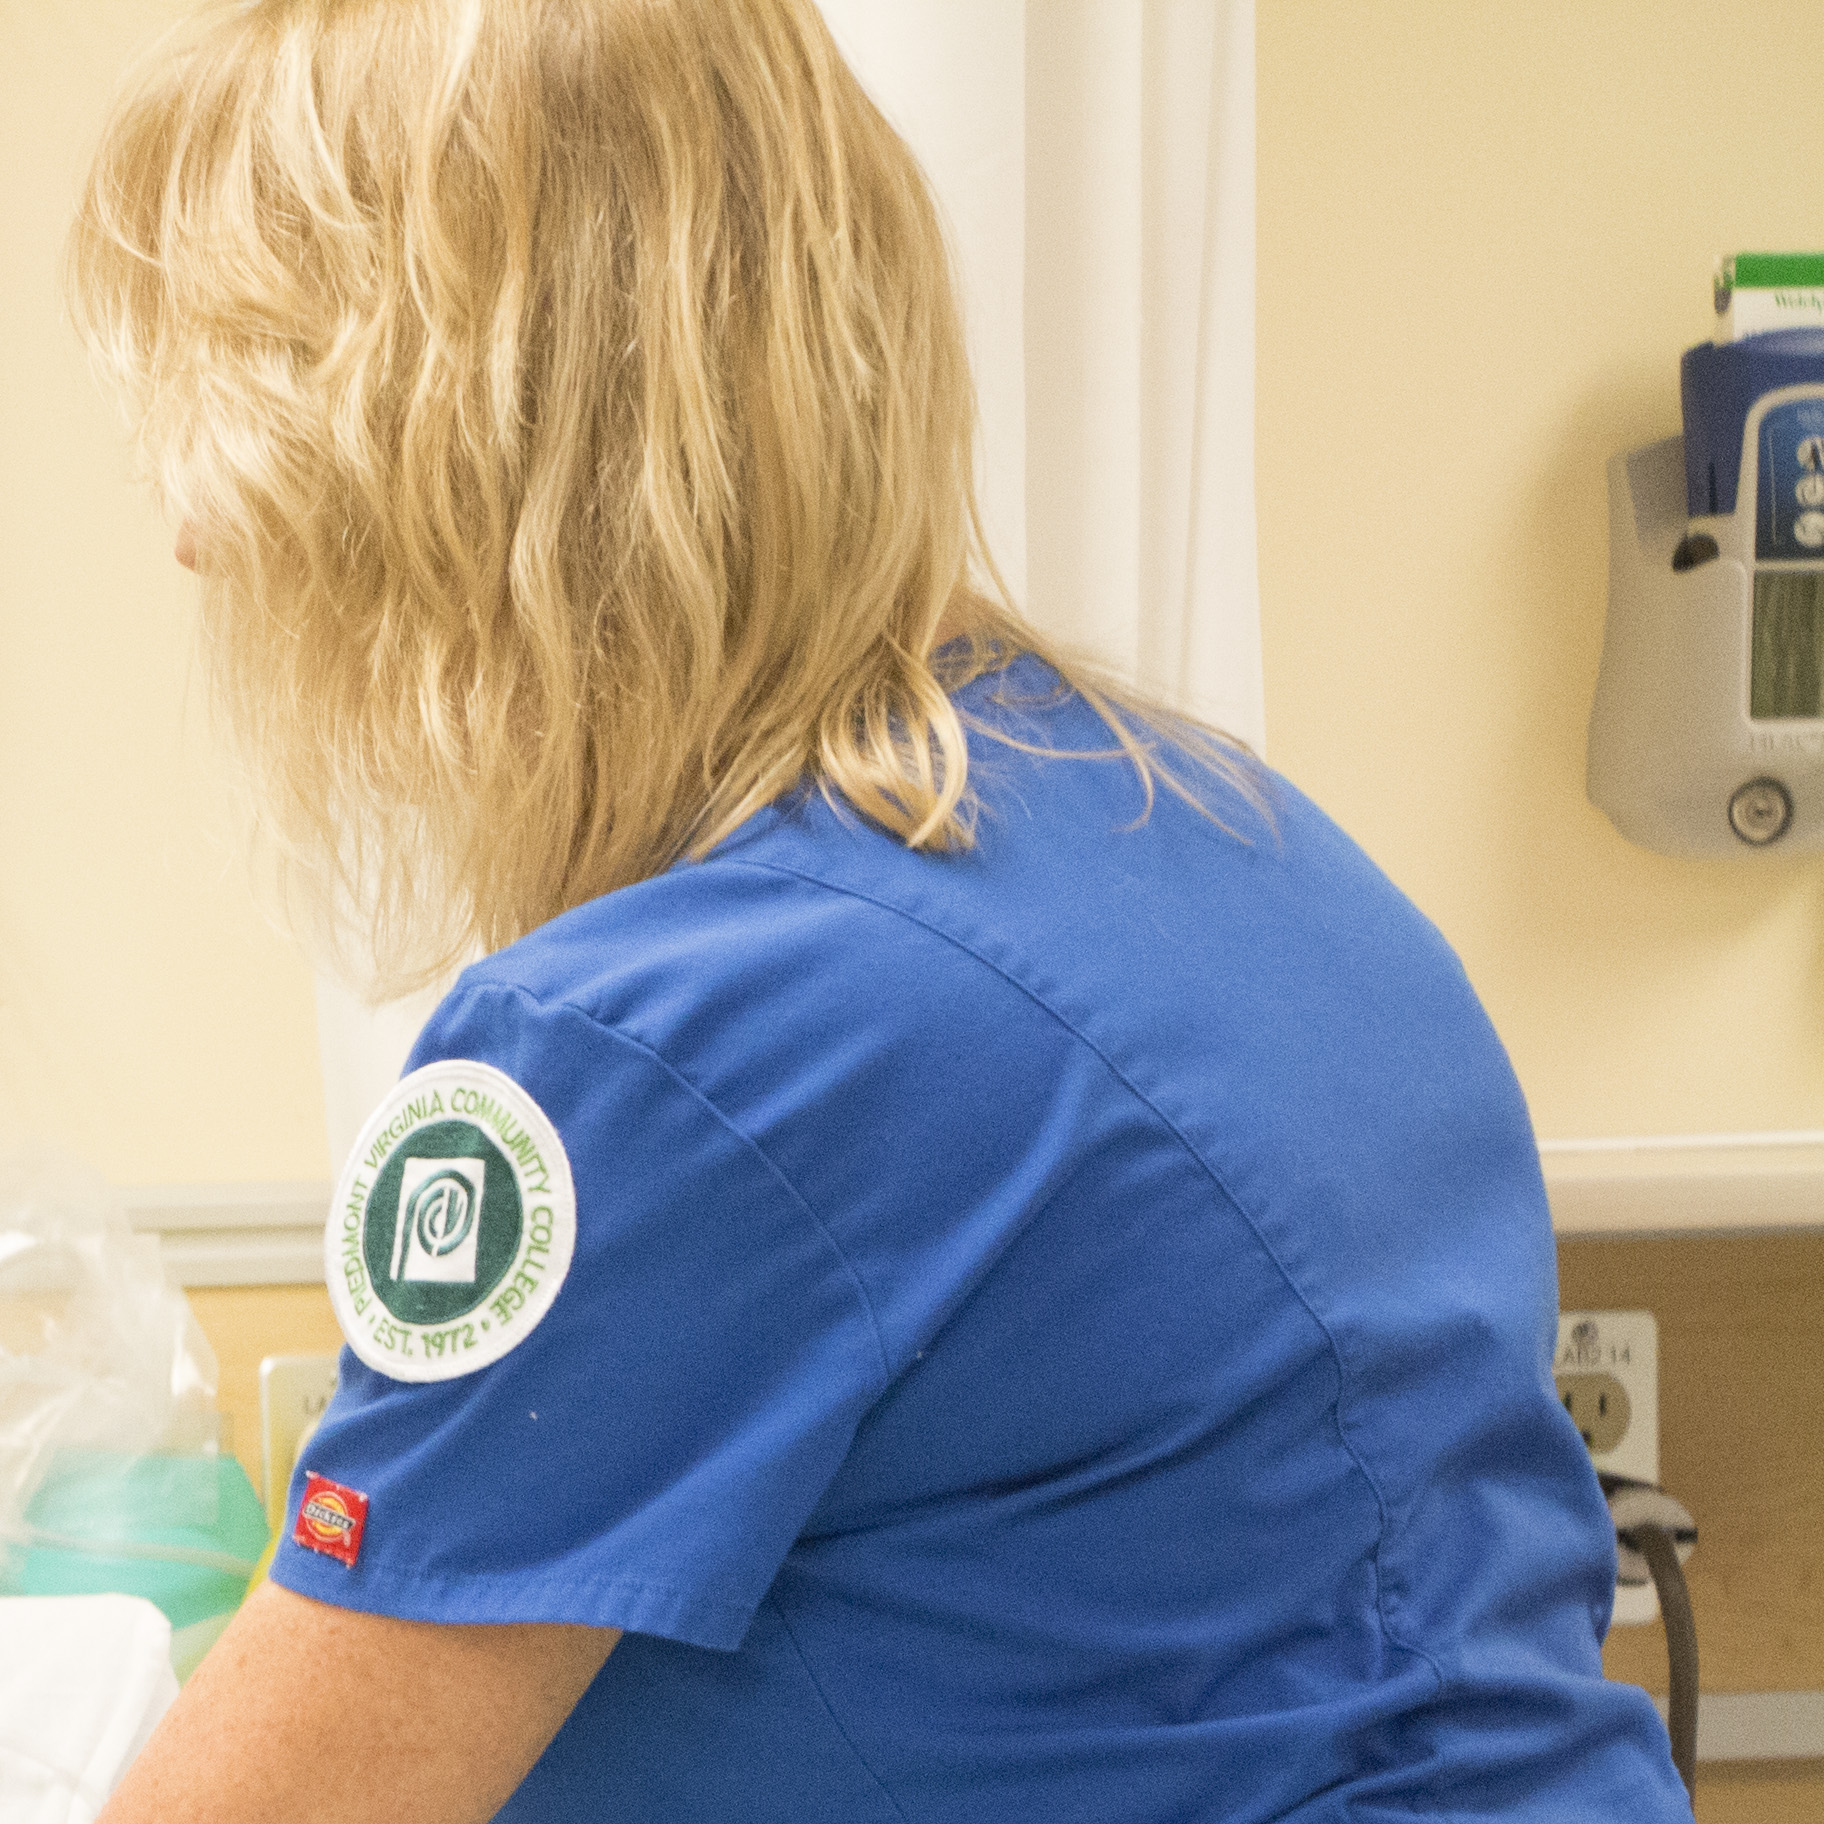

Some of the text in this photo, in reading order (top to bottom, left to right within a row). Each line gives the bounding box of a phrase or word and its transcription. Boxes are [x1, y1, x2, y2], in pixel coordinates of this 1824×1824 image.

[341, 1086, 554, 1326] PIEDMONT VIRGINIA COMMUNITY COLLEGE
[372, 1320, 478, 1359] EST. 1972
